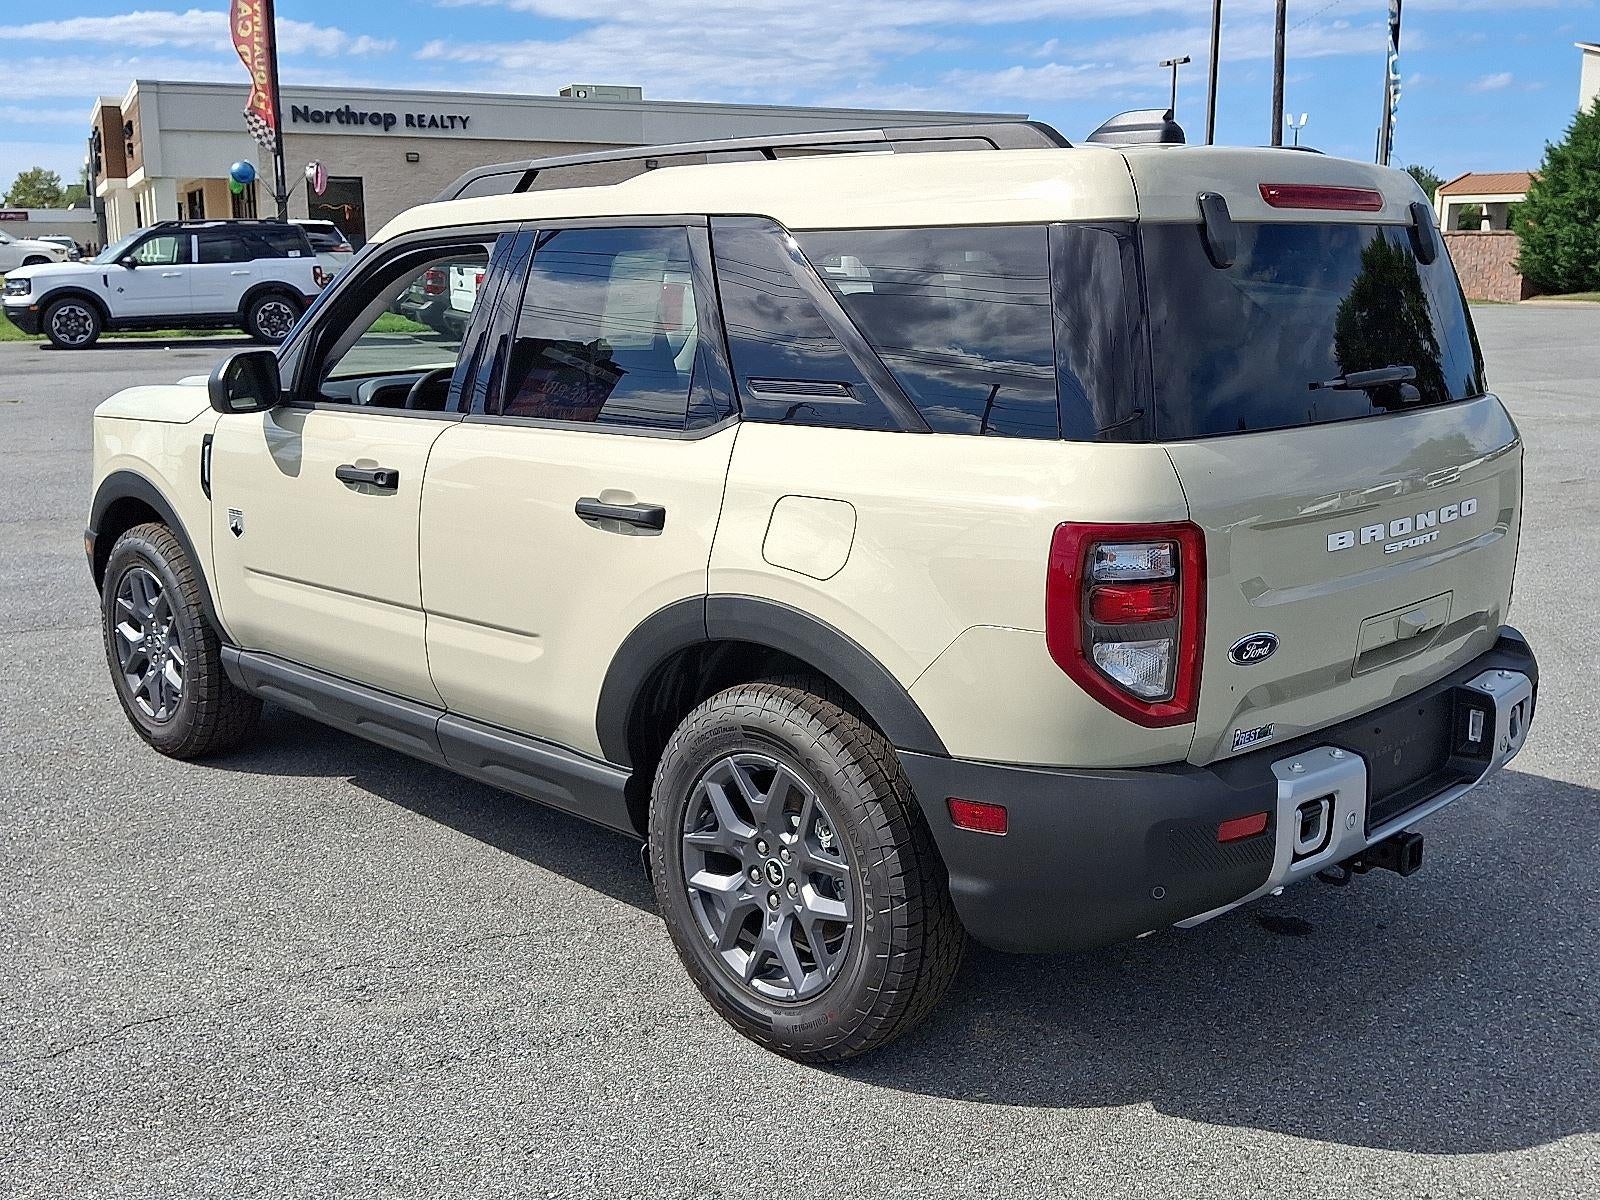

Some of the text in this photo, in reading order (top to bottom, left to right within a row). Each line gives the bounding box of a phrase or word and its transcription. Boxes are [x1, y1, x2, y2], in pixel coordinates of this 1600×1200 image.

[291, 105, 470, 131] Northrop REALTY
[1327, 498, 1477, 552] BRONCO
[1384, 530, 1440, 554] SPORT
[1242, 640, 1270, 660] Ford
[1233, 723, 1274, 748] PRESTN
